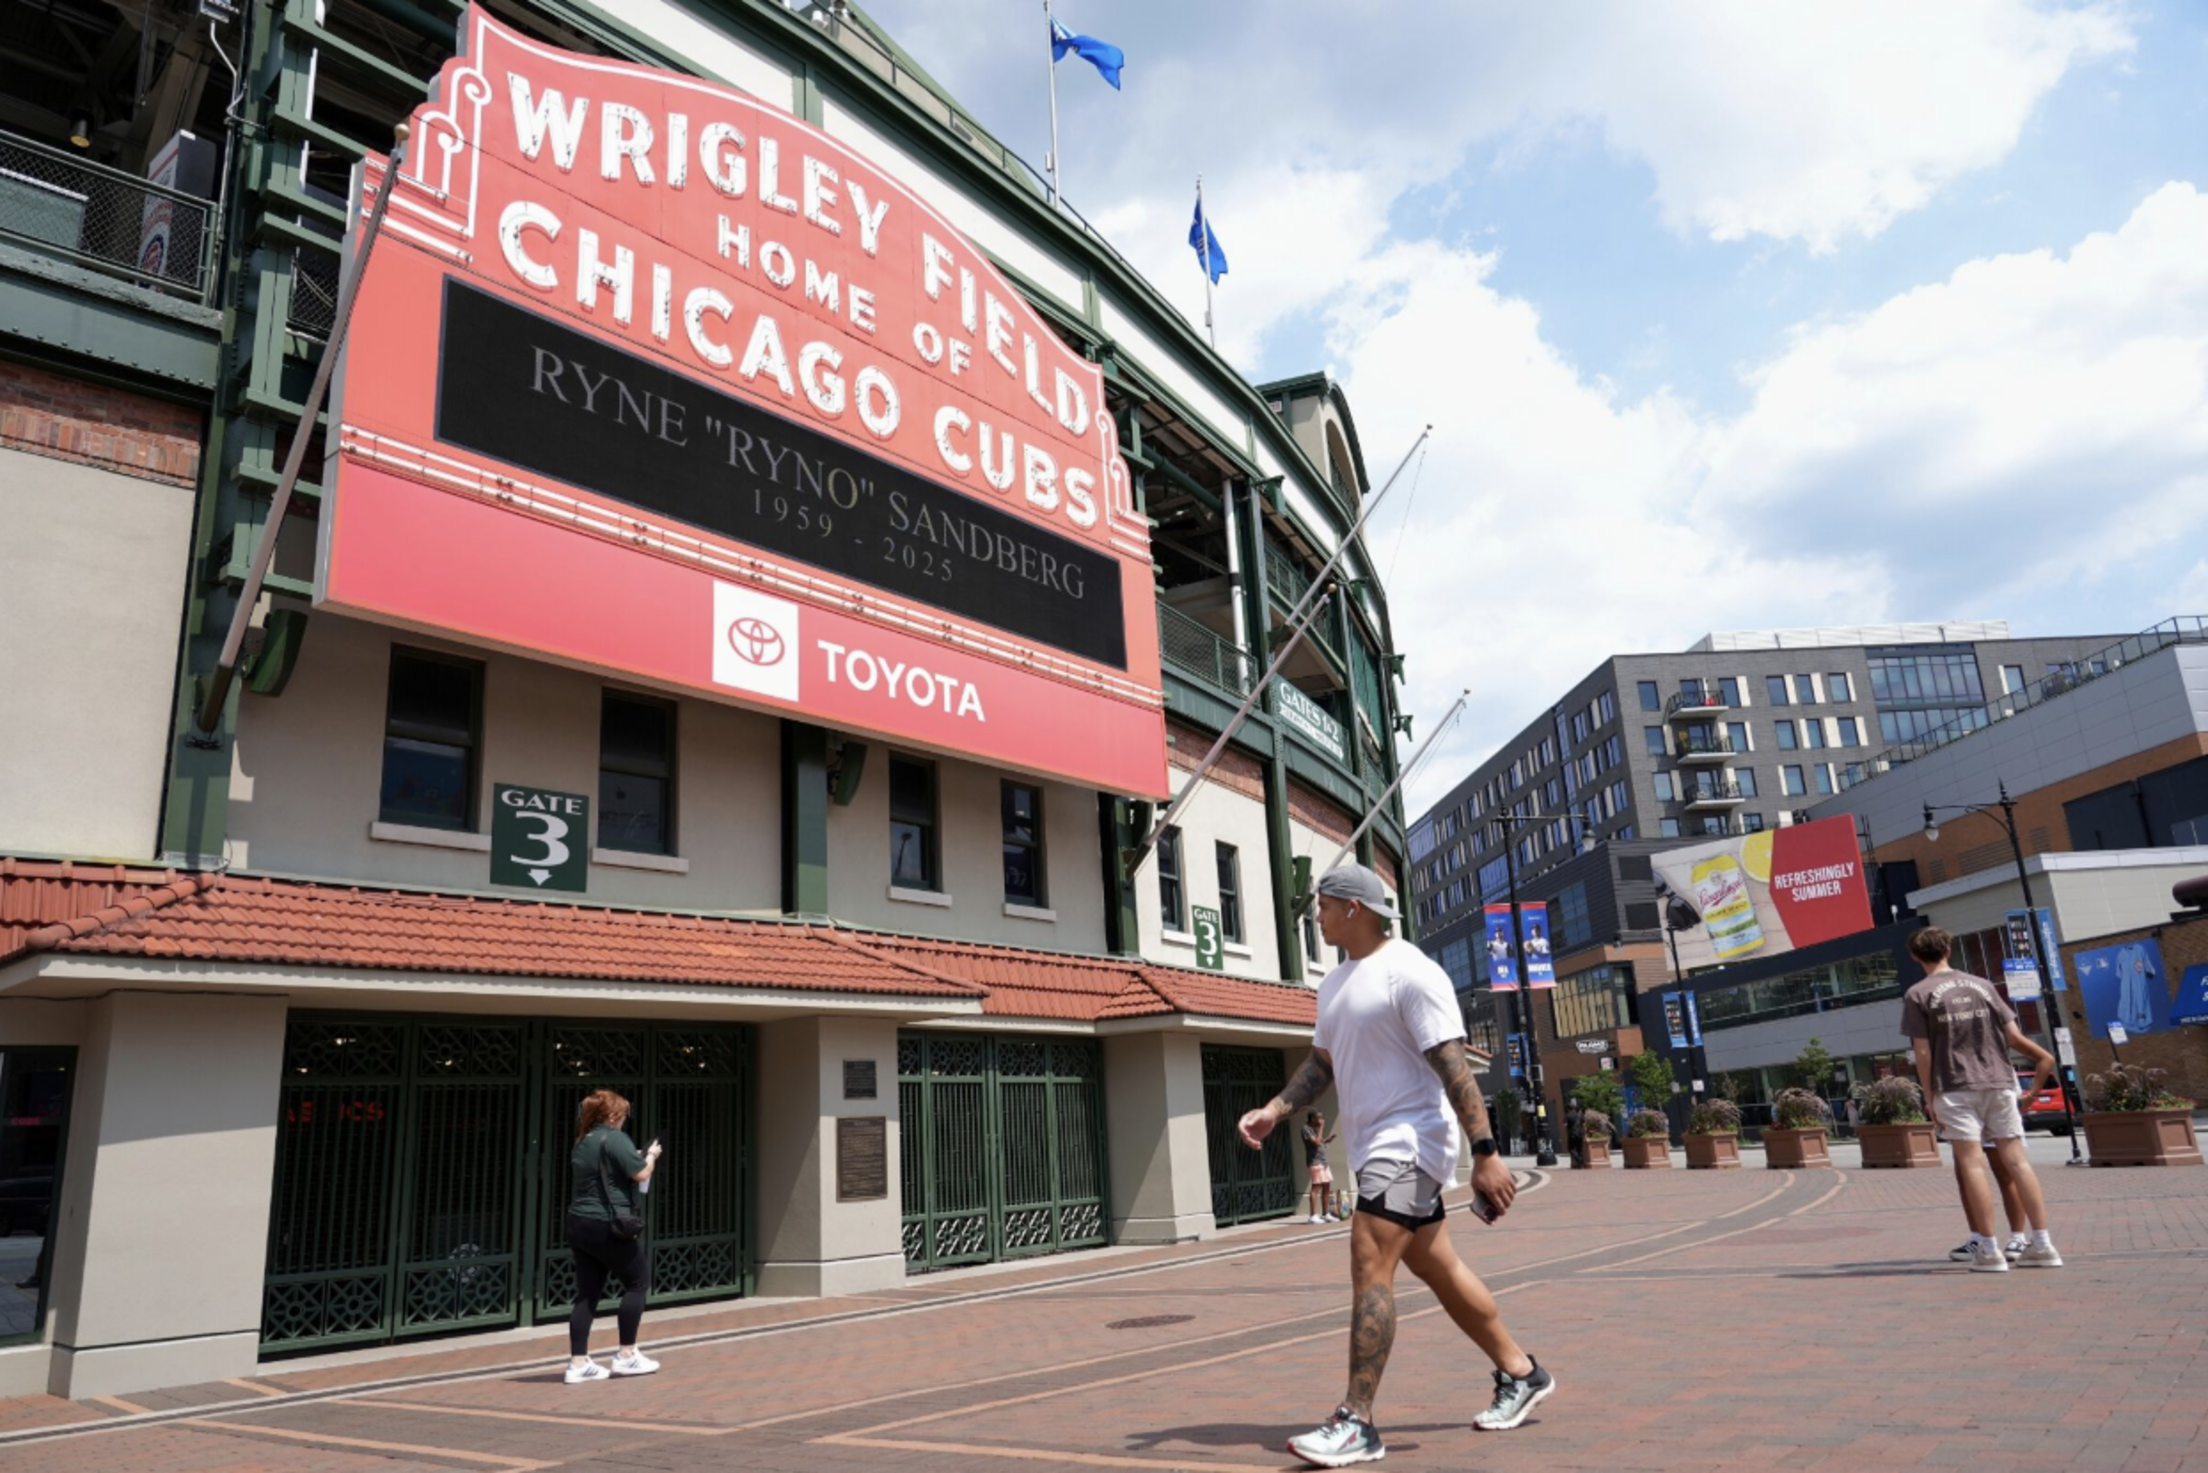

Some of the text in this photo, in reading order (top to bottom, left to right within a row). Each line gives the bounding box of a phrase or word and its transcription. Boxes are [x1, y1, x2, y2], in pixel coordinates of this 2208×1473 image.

[506, 71, 1090, 436] WRIGLEY FIELD
[717, 213, 971, 375] HOME OF
[499, 201, 1098, 527] CHICAGO CUBS
[529, 345, 1085, 598] RYNE "RYNO" SANDBERG
[754, 489, 833, 537] 1959
[884, 537, 953, 581] 2025
[817, 639, 986, 722] TOYOTA
[1280, 682, 1321, 726] GATES
[501, 789, 583, 815] GATE
[510, 811, 570, 867] 3
[1774, 862, 1854, 889] REFRESHINGLY
[1792, 882, 1842, 902] SUMMER
[1194, 908, 1219, 923] GATE
[1199, 921, 1218, 956] 3
